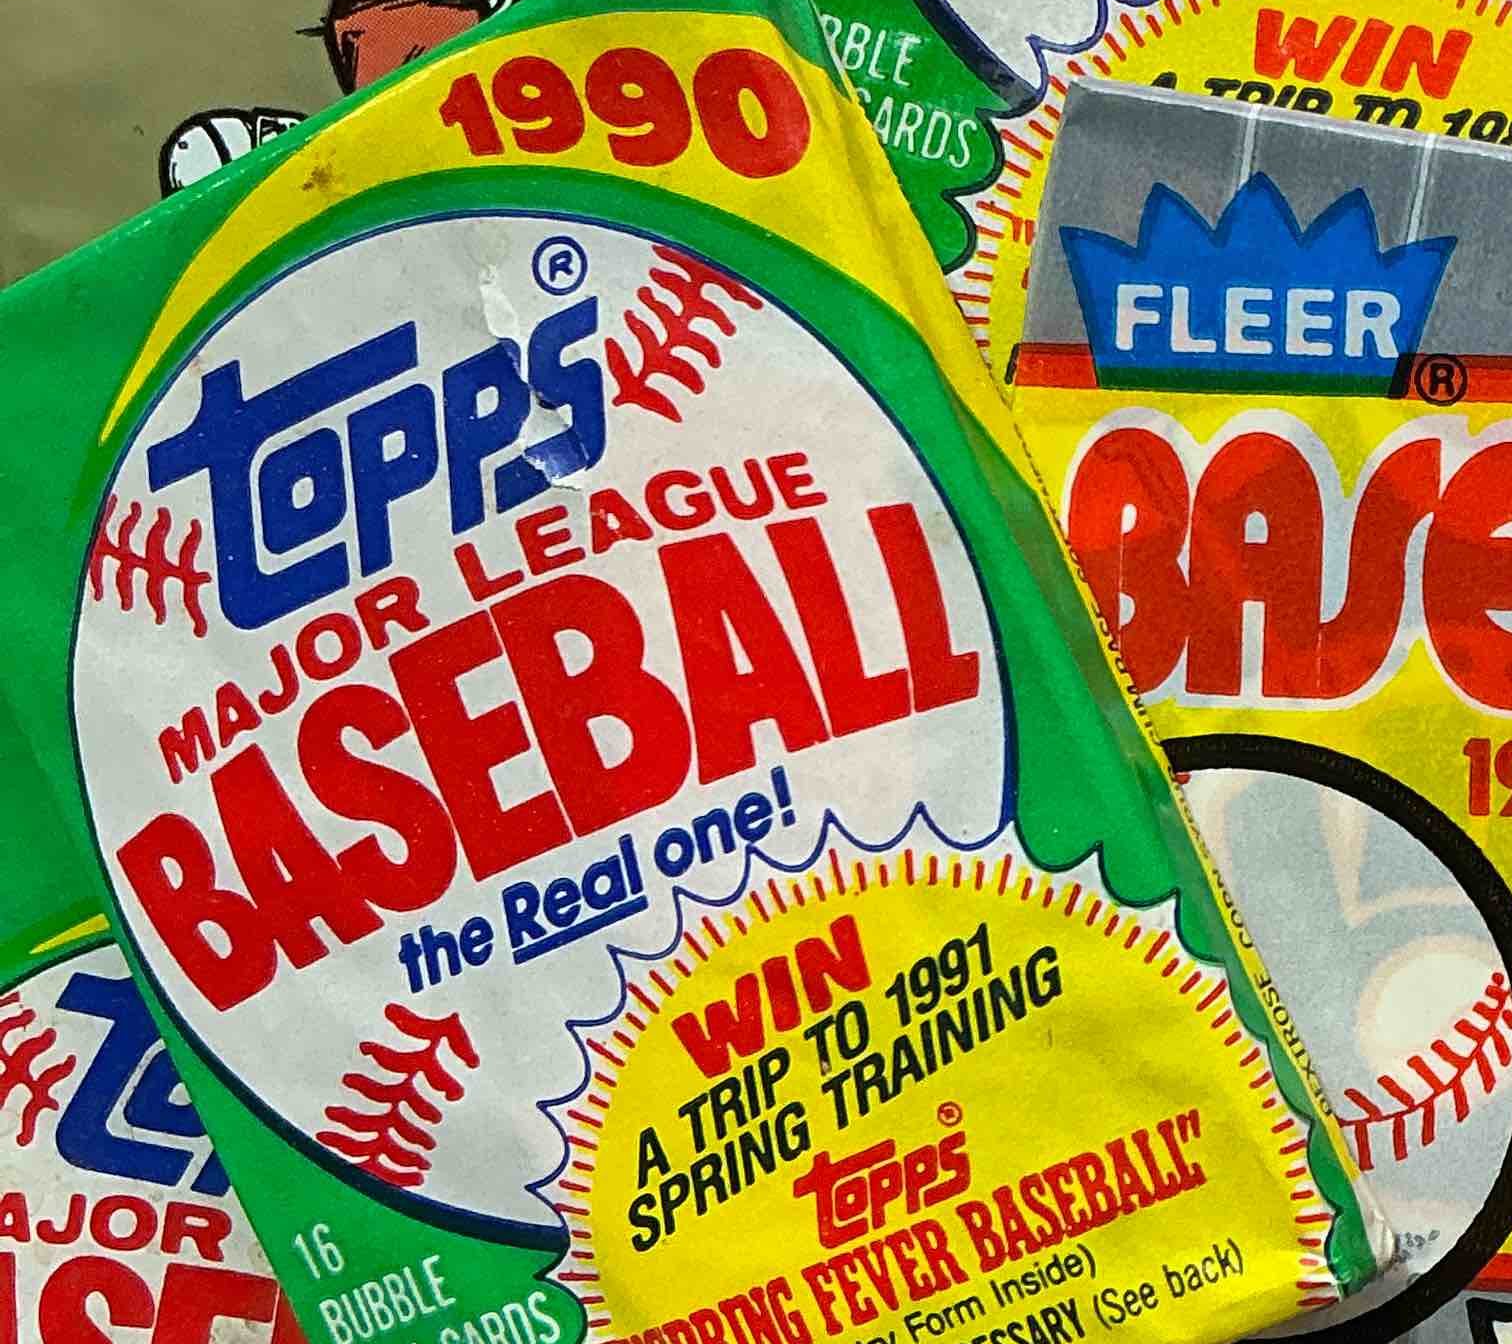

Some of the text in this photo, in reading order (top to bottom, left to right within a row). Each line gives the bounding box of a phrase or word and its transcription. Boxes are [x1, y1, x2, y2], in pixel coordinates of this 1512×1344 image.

[438, 45, 812, 181] 1990
[1251, 8, 1475, 102] WIN
[1113, 282, 1403, 361] FLEER
[157, 573, 431, 786] MAJOR
[452, 449, 831, 597] LEAGUE
[115, 501, 982, 1013] BASEBALL
[399, 767, 800, 996] the Real one!
[637, 922, 996, 1189] A TRIP TO 1991
[670, 913, 873, 1080] WIN
[627, 943, 1066, 1254] SPRING TRAINING
[292, 1221, 346, 1282] 16
[817, 1226, 955, 1344] FEVER
[964, 1107, 1209, 1281] BASEBALL"
[992, 1243, 1099, 1314] Inside)
[1093, 1284, 1161, 1332] (See
[1163, 1236, 1245, 1298] back)
